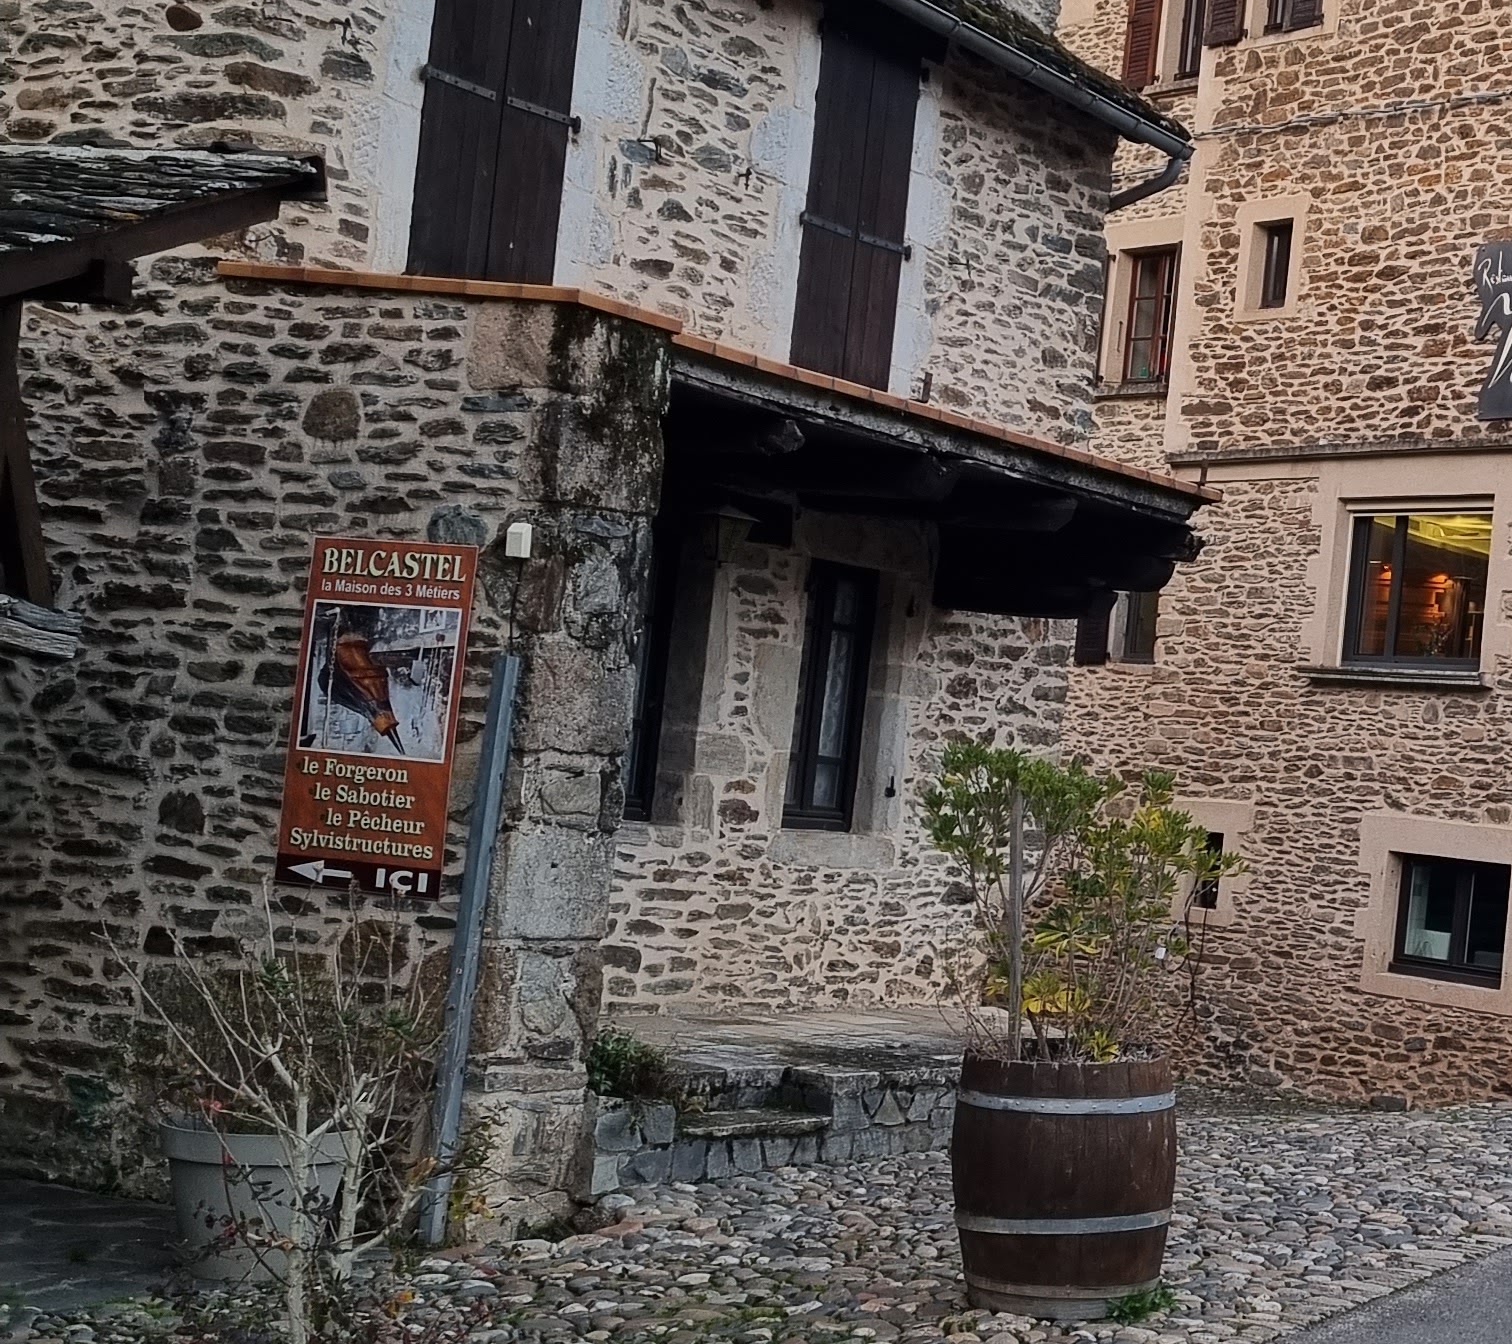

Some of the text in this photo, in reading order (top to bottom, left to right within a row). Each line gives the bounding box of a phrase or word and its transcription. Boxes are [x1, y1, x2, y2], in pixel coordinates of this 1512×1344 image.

[322, 548, 466, 582] BELCASTEL
[322, 578, 461, 601] la Maison des 3 Métiers
[302, 756, 408, 783] le Forgeron
[314, 783, 415, 809] le Sabotier
[326, 808, 425, 835] le Pêcheur
[289, 827, 434, 859] Sylvistructures
